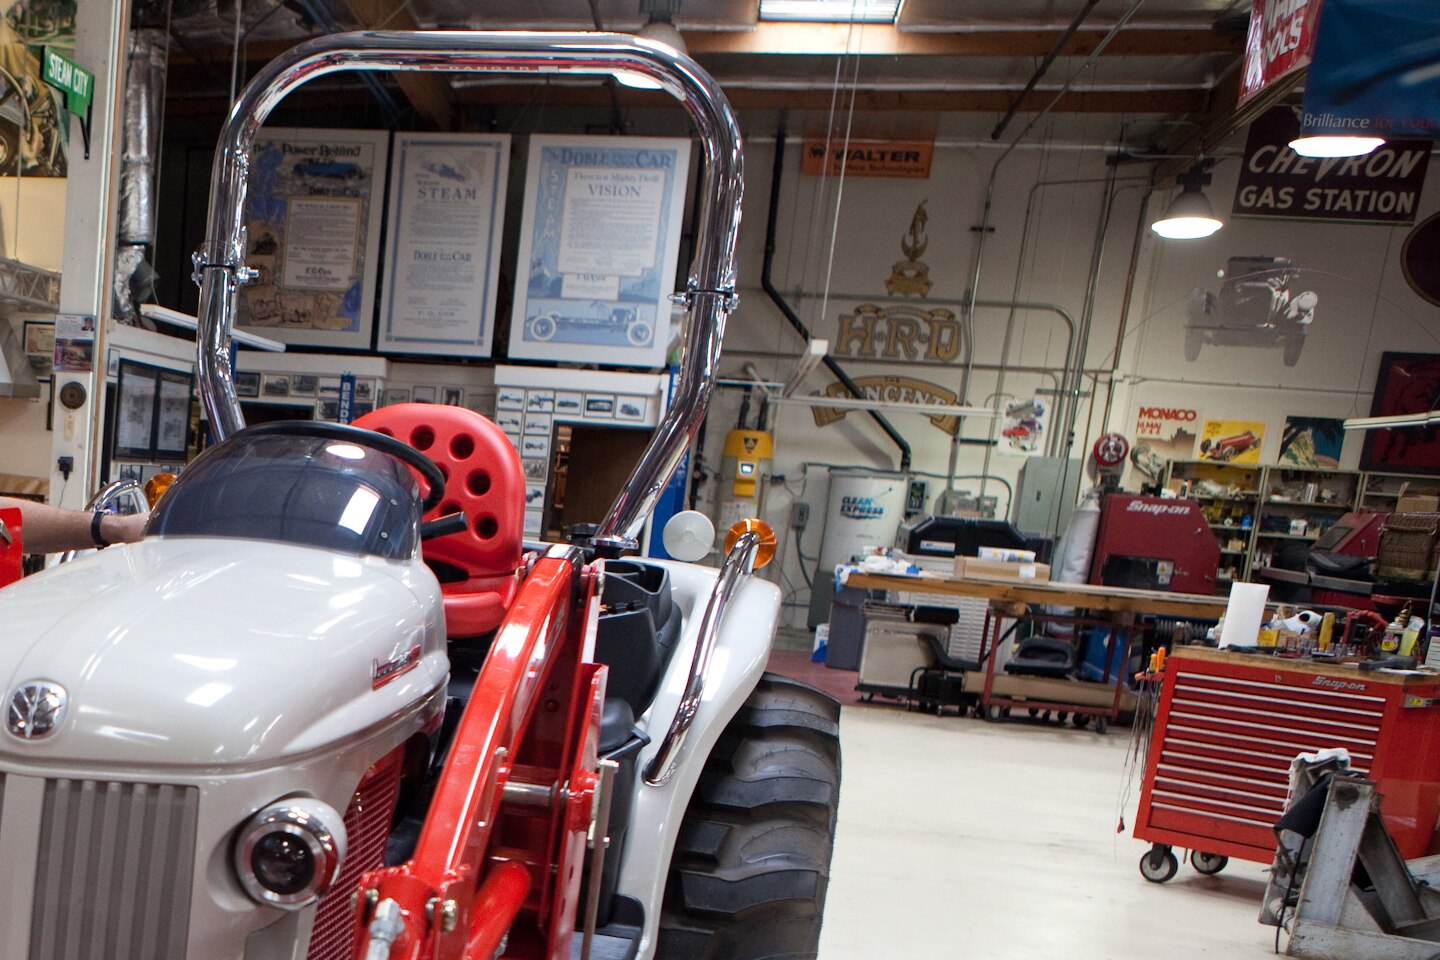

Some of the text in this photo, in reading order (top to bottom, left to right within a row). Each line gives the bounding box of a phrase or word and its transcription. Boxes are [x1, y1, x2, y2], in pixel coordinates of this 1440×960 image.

[49, 53, 89, 97] STEAM CITY
[1303, 113, 1370, 129] Brilliance
[833, 149, 920, 162] WALTER
[1248, 144, 1426, 182] CHEVRON
[418, 186, 477, 200] STEAM
[588, 184, 641, 197] VISION
[1239, 185, 1416, 213] GAS STATION
[1139, 407, 1197, 421] MONACO
[842, 496, 874, 505] CLEAN
[1126, 500, 1190, 516] Snap-on
[841, 505, 884, 515] EXPRESS
[1312, 675, 1366, 691] Snap-on
